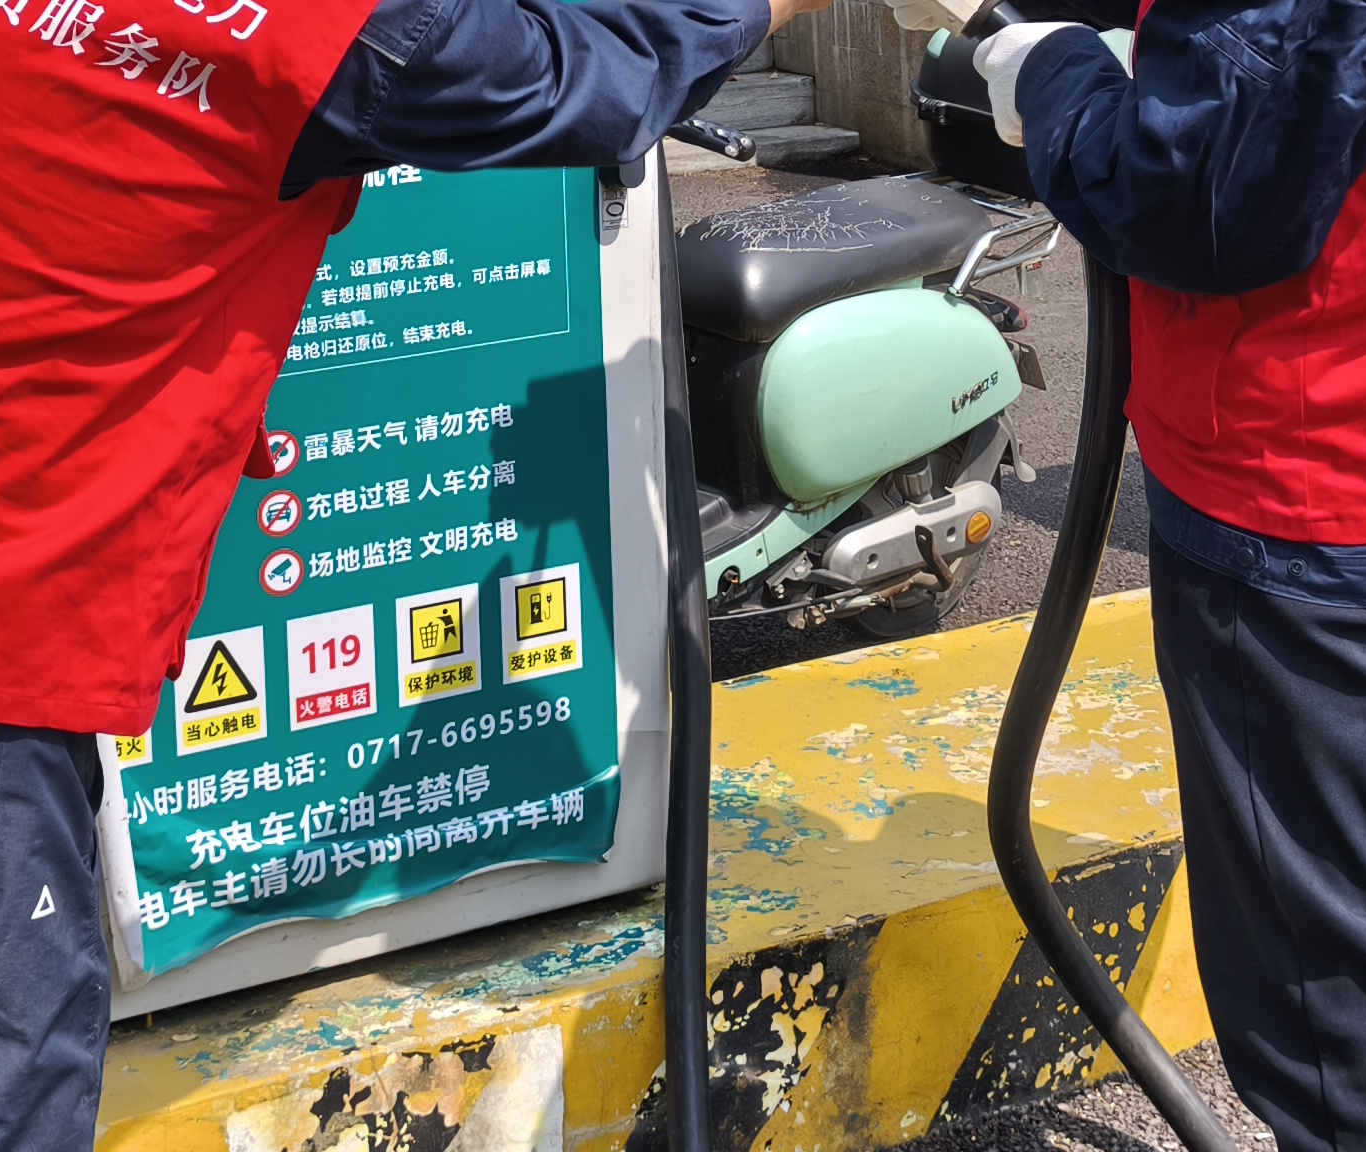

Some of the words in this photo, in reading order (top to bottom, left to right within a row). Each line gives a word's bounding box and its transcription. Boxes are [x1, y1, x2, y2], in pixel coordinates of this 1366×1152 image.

[285, 319, 473, 362] 电枪归还原位，结束充电。
[304, 420, 408, 462] 雷暴天气
[415, 403, 514, 443] 请勿充电
[306, 478, 411, 521] 充电过程
[417, 460, 516, 501] 人车分离
[309, 536, 412, 579] 场地监控
[419, 517, 519, 559] 文明充电
[301, 634, 362, 675] 119
[510, 644, 574, 672] 爱护设备
[407, 665, 474, 693] 保护环境
[298, 689, 368, 719] 火警电话
[186, 713, 257, 743] 当心触电
[124, 752, 327, 825] 小时服务电话：
[347, 696, 571, 769] 0717-6695598
[186, 764, 491, 870] 充电车位油车禁停
